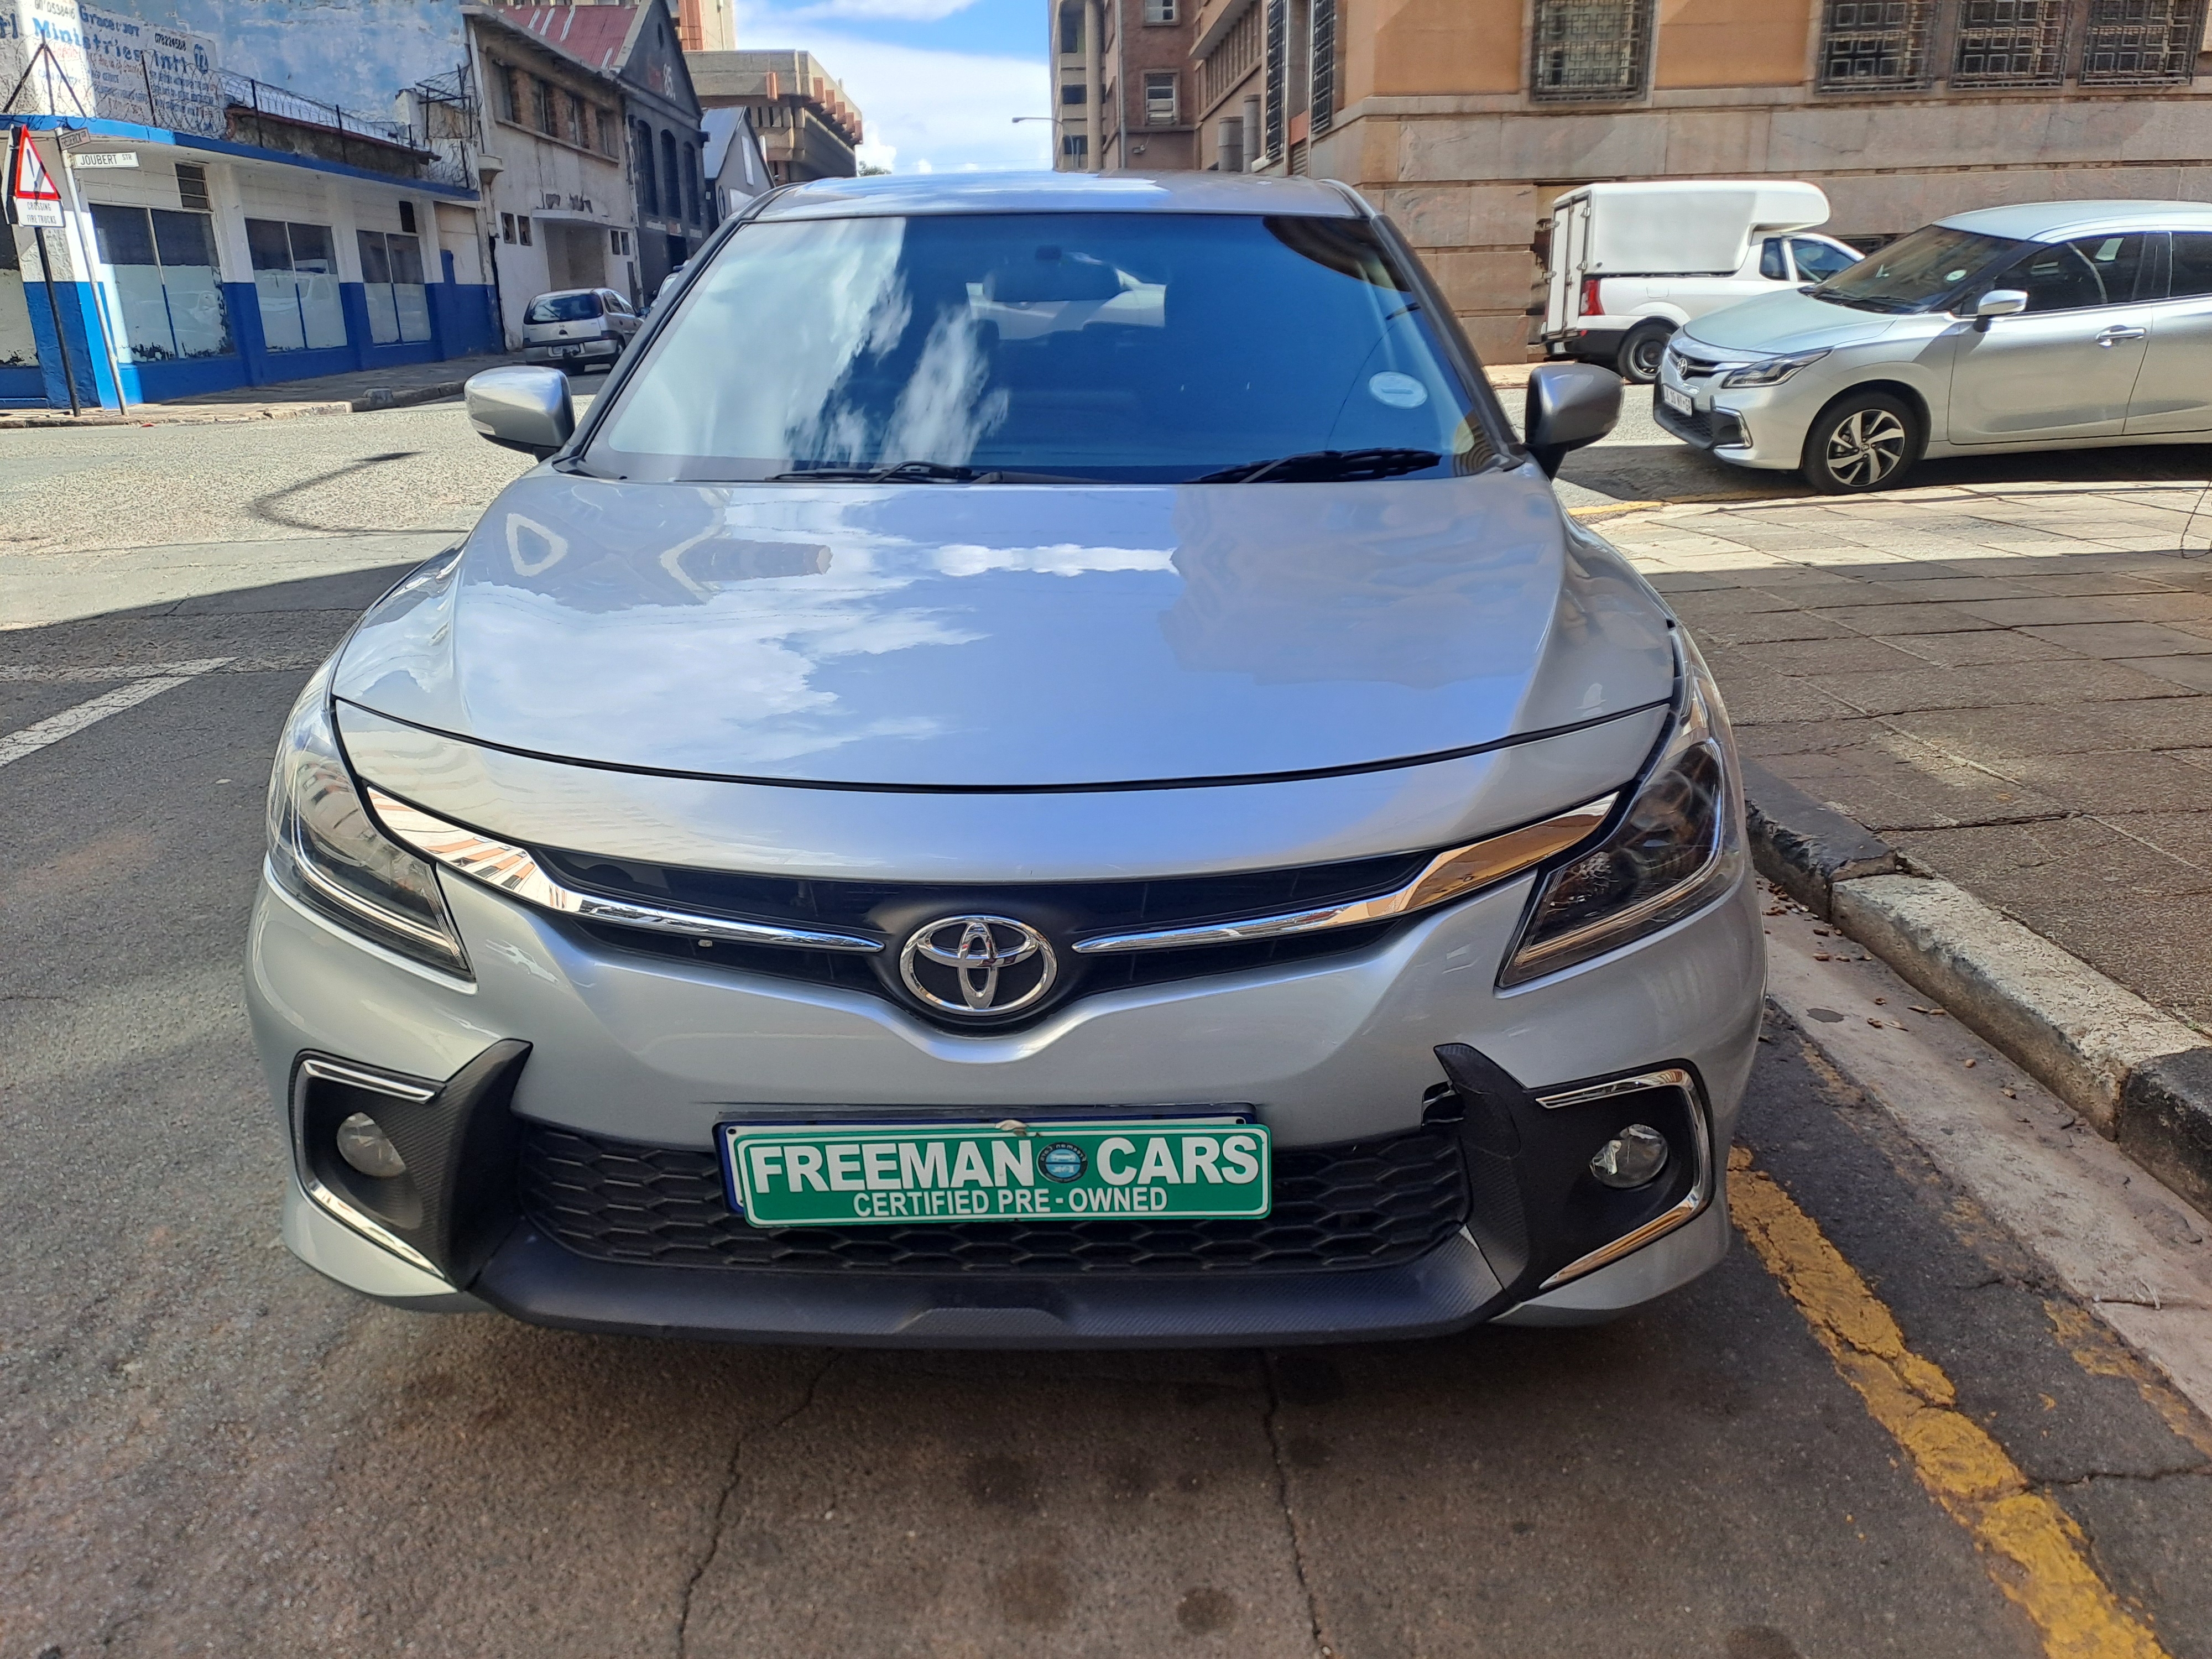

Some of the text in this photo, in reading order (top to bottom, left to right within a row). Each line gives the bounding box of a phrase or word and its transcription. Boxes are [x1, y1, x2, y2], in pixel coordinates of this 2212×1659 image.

[80, 154, 117, 165] JOUBERT
[27, 201, 51, 211] CROSSING
[749, 1136, 1259, 1193] FREEMAN CARS
[853, 1190, 989, 1217] CERTIFIED
